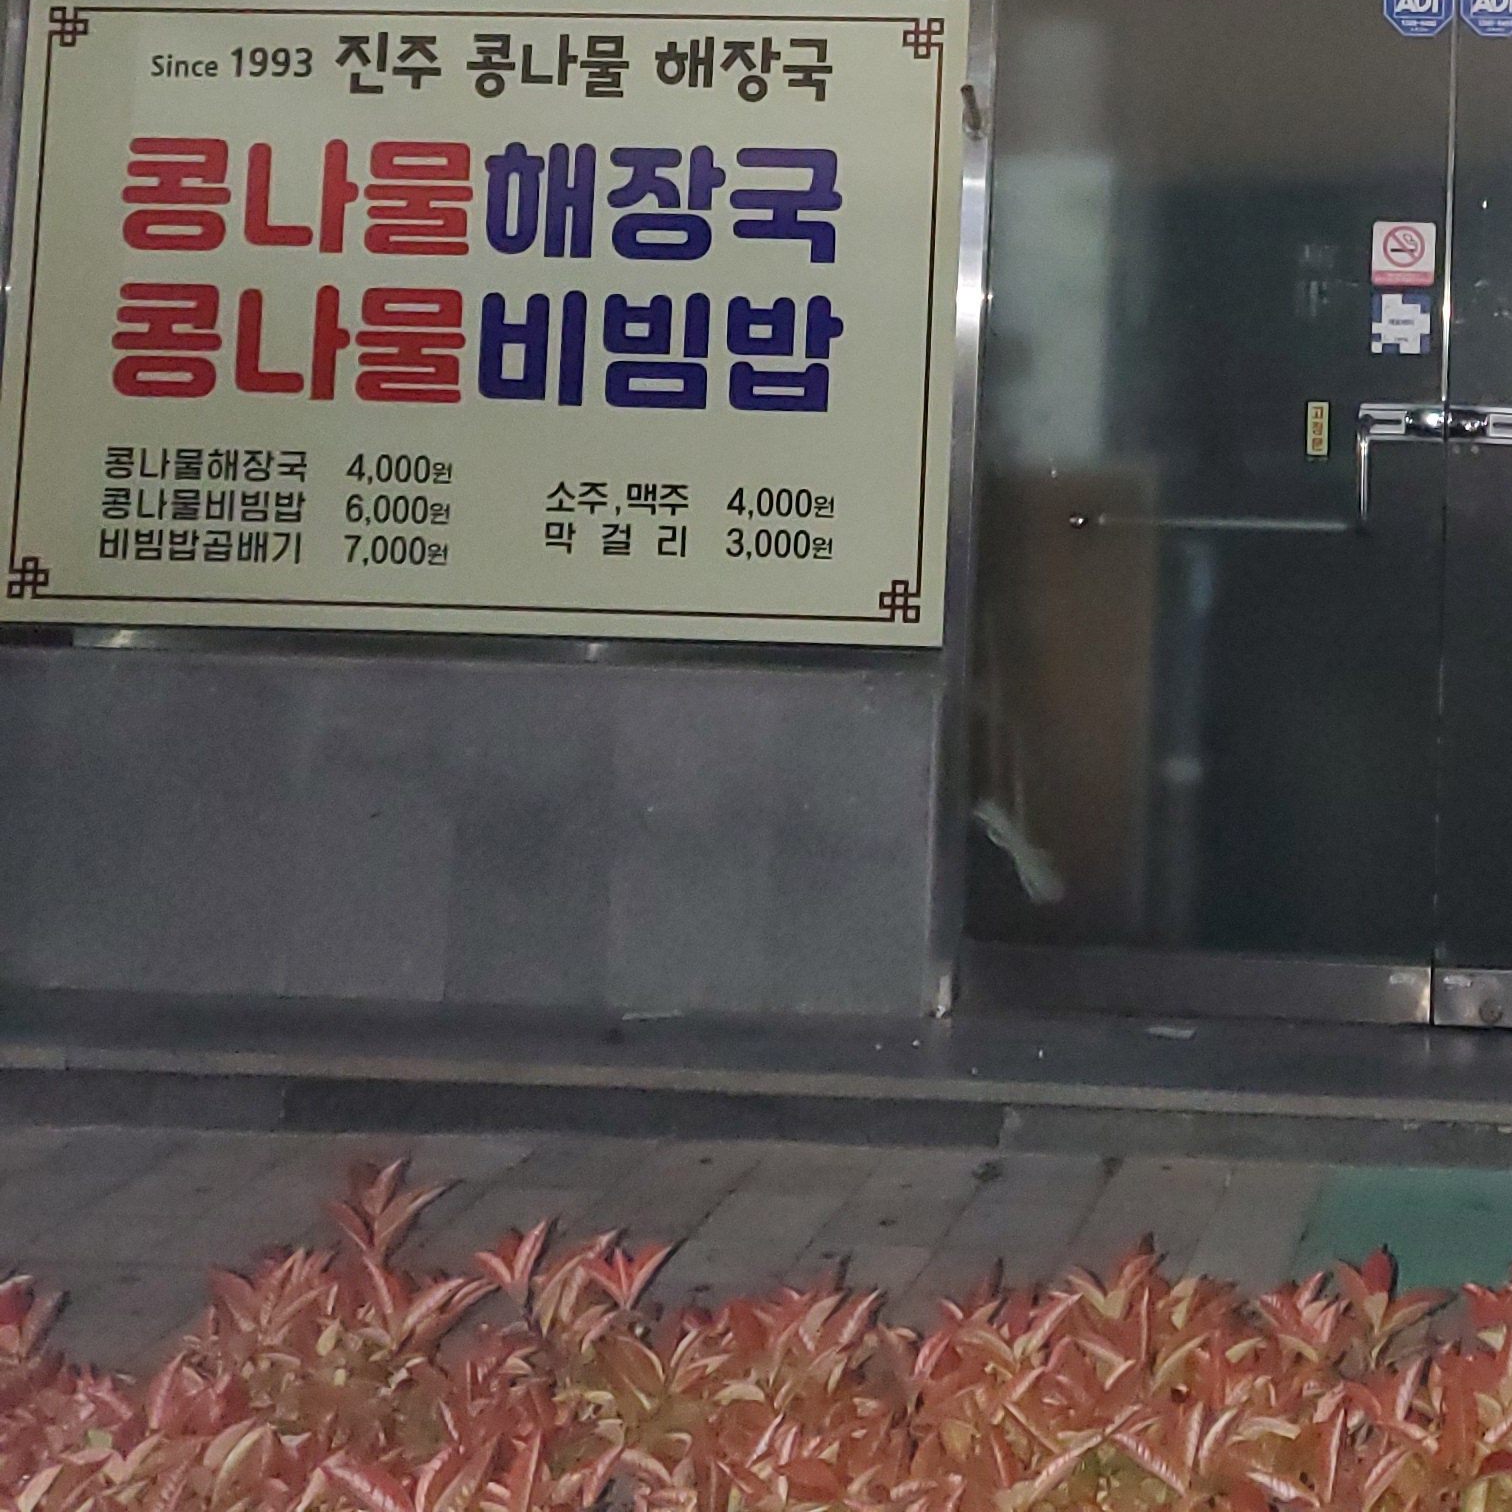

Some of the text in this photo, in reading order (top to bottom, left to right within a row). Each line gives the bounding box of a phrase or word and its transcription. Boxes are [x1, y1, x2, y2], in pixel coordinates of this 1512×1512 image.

[150, 31, 833, 103] Since 1993 진주 콩나물 해장국
[121, 137, 843, 264] 콩나물해장국
[111, 282, 844, 413] 콩나물비빔밥
[104, 446, 453, 485] 콩나물해장국 4,000원
[101, 487, 450, 526] 콩나물비빔밥 6,000원
[545, 481, 835, 520] 소주,맥주 4,000원
[99, 527, 448, 567] 비빔밥곱배기 7,000원
[725, 527, 833, 561] 3,000원
